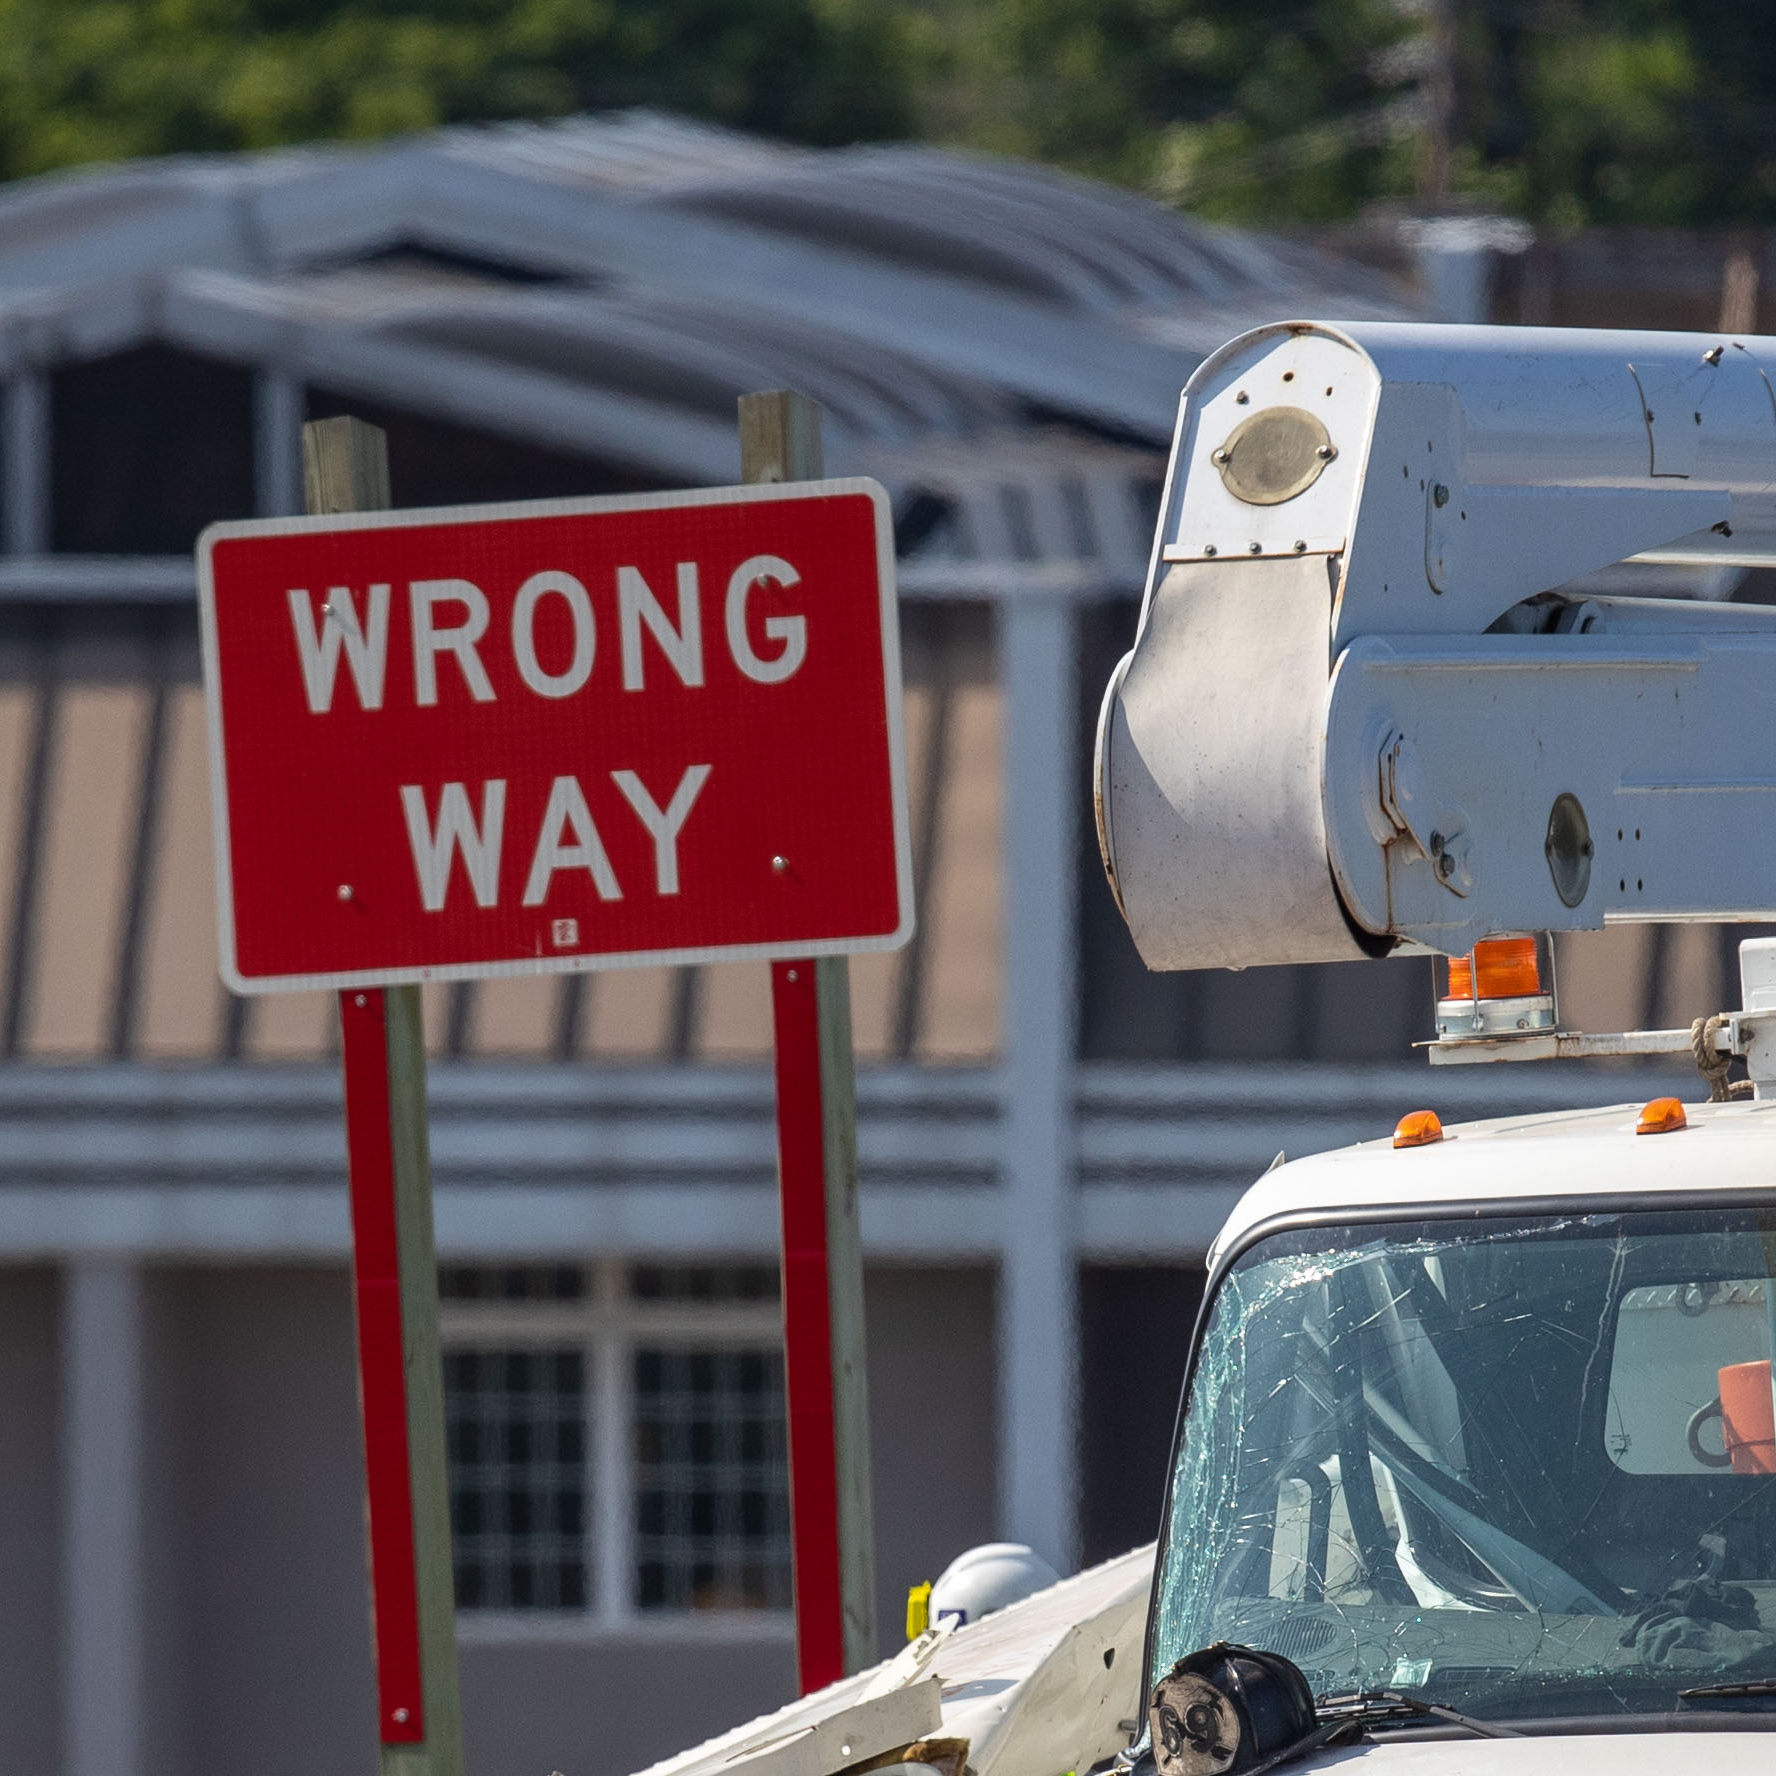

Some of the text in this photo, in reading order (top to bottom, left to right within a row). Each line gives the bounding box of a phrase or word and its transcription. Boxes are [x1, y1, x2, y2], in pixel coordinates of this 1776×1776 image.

[287, 554, 807, 715] WRONG
[400, 764, 713, 912] WAY
[1159, 1702, 1220, 1757] 69
